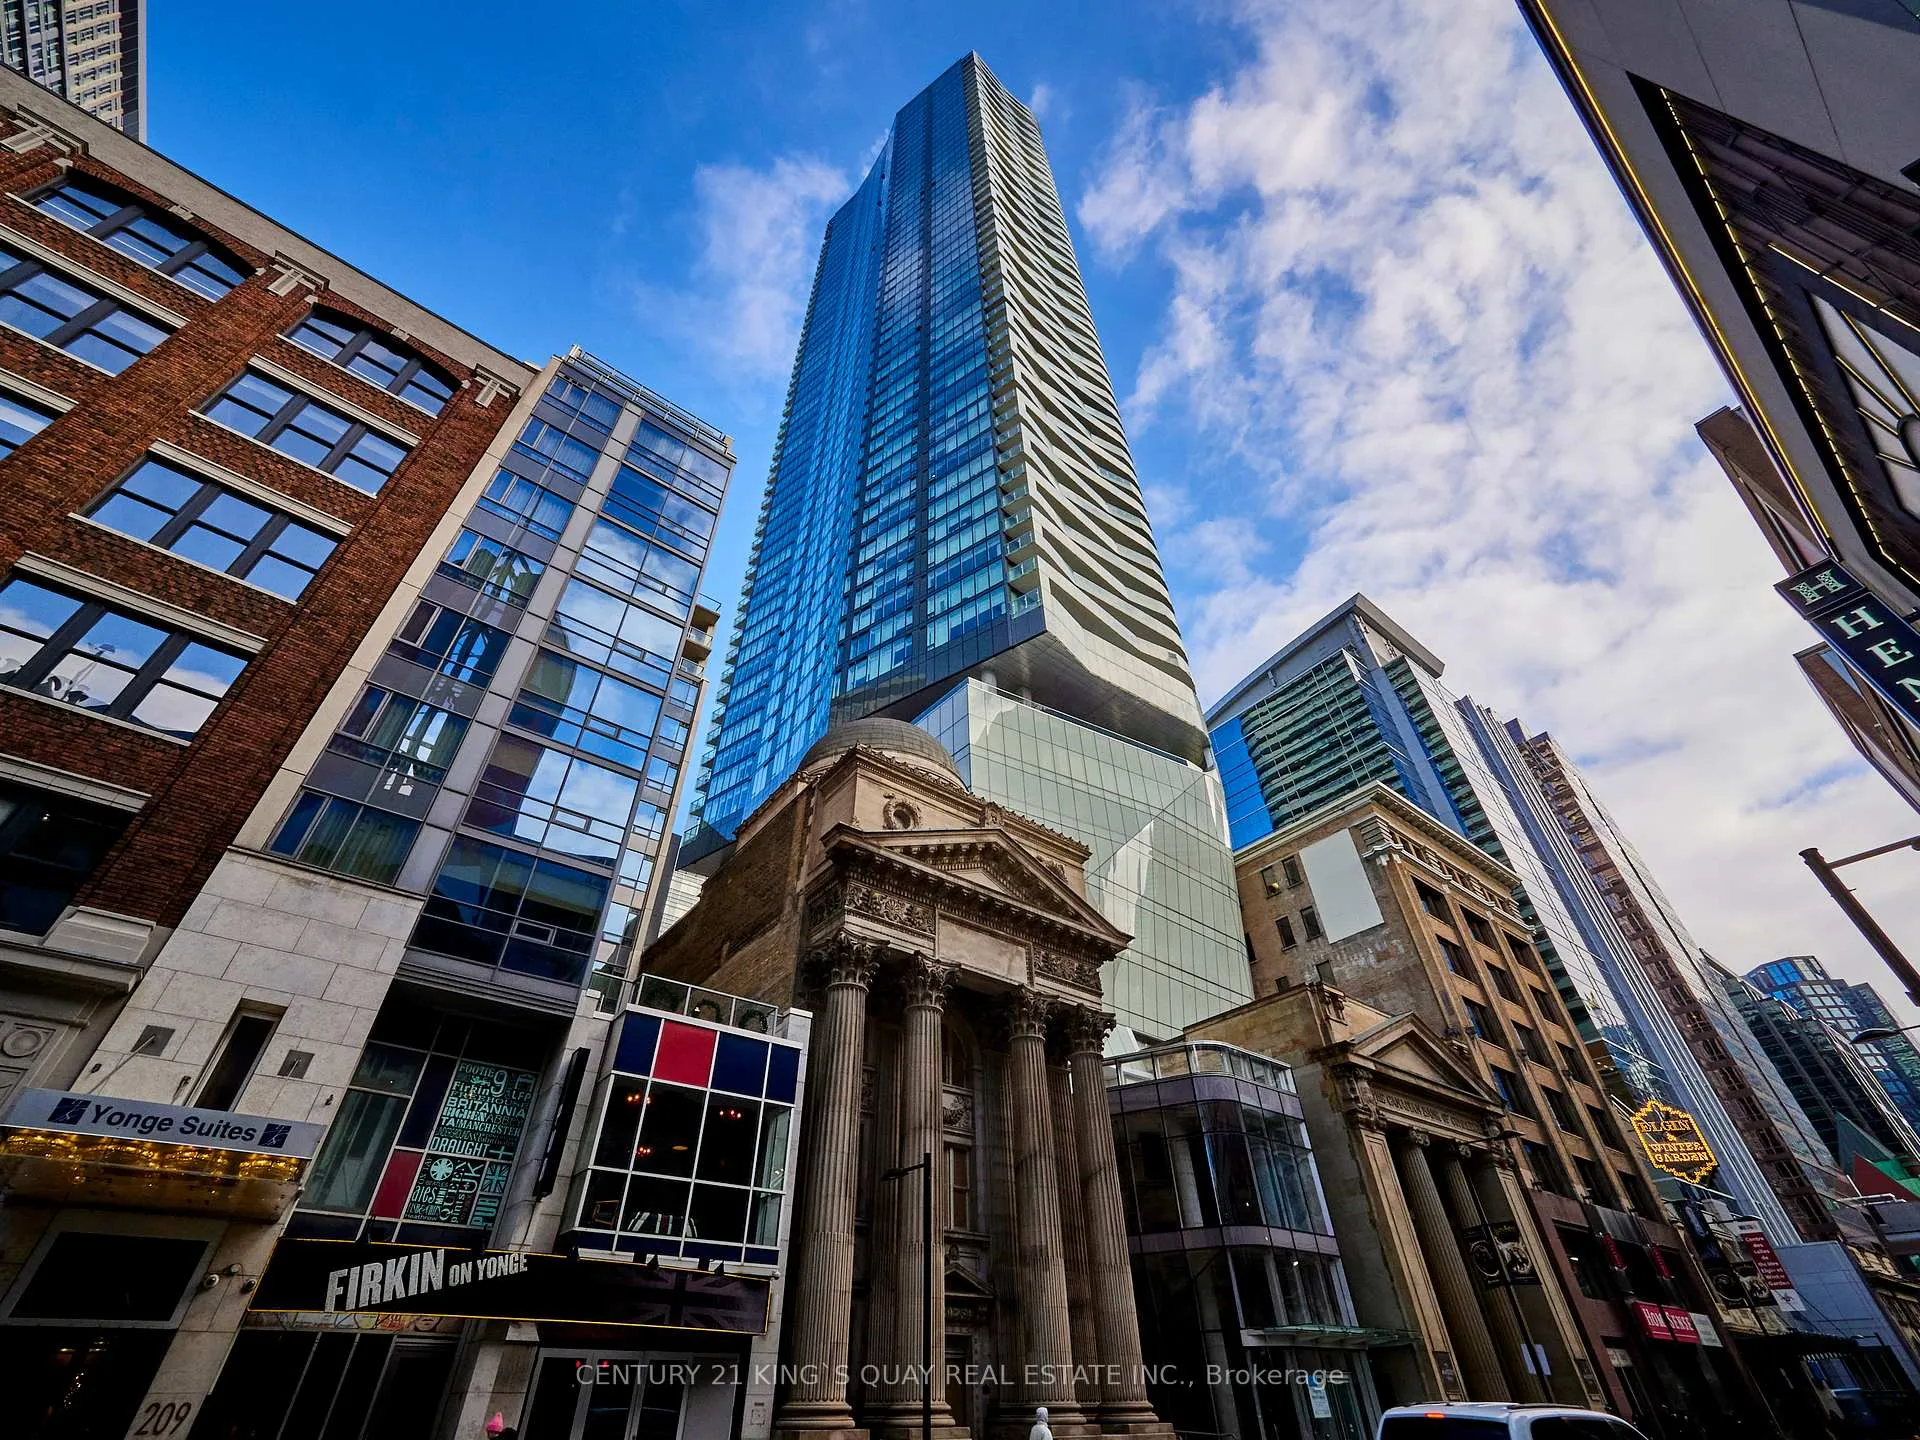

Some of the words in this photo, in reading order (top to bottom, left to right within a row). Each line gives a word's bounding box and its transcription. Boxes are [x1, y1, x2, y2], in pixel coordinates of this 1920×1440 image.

[452, 1081, 490, 1095] Firkin
[446, 1096, 526, 1118] BRITANNIA
[89, 1104, 174, 1135] Yonge
[179, 1116, 257, 1142] Suites
[1638, 1120, 1691, 1132] ELGIN
[430, 1137, 490, 1158] DRAUGHT
[1649, 1142, 1704, 1152] WINTER
[1655, 1152, 1709, 1162] GARDEN
[459, 1162, 484, 1193] UK
[412, 1186, 437, 1204] ales
[324, 1249, 444, 1313] FIRKIN
[449, 1261, 473, 1287] ON
[477, 1252, 528, 1281] YONGE
[134, 1402, 192, 1435] 209
